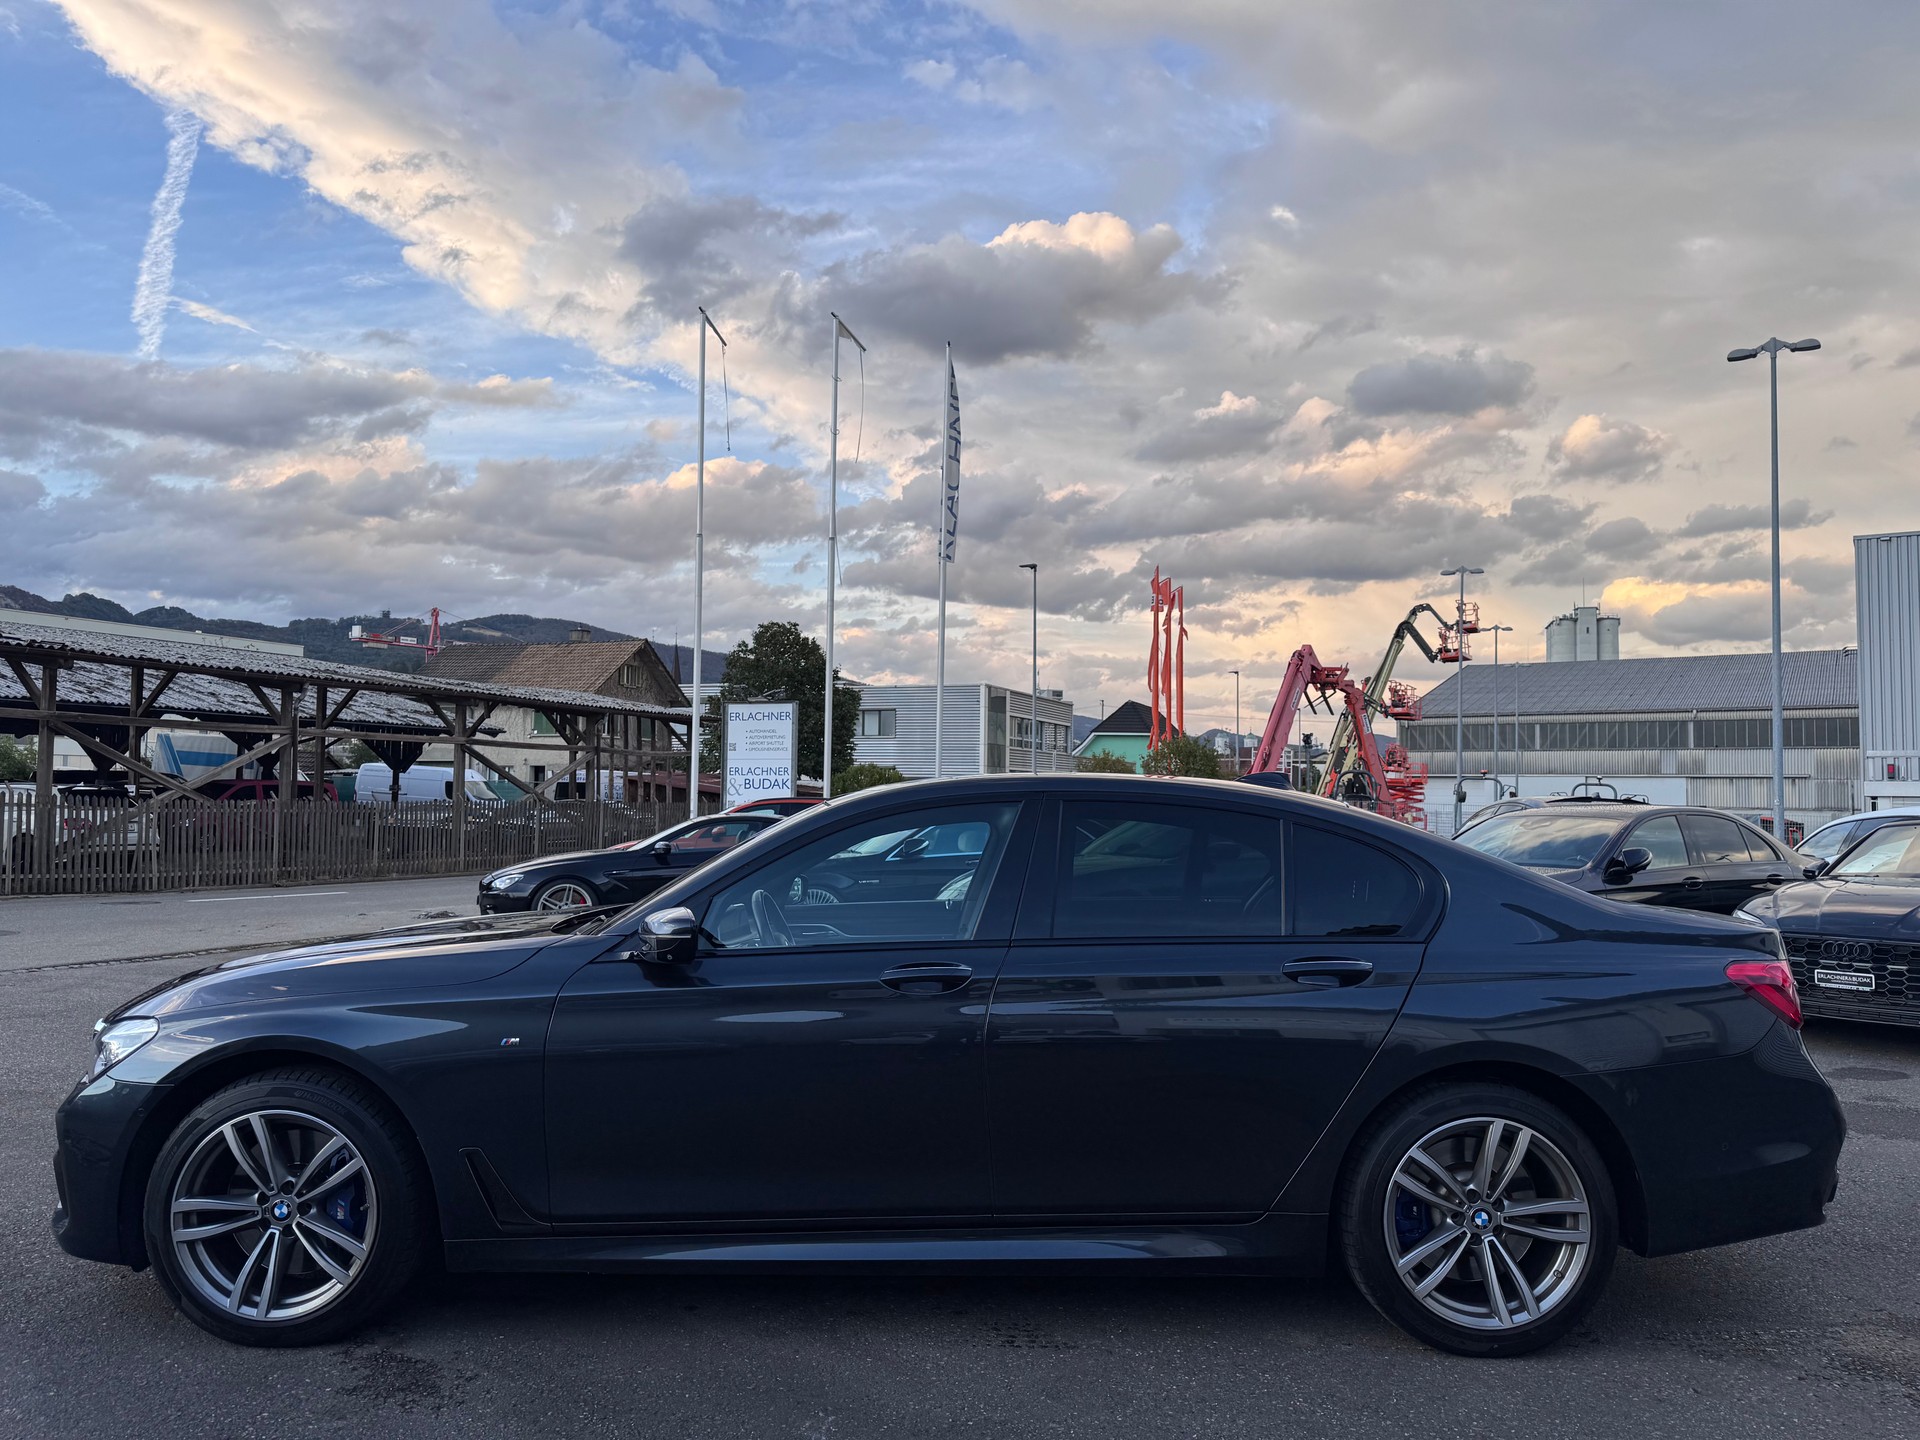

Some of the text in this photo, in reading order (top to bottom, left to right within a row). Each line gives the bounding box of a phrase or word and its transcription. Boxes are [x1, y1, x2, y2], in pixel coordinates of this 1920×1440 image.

[729, 712, 792, 721] ERLACHNER
[728, 767, 790, 776] ERLACHNER
[727, 777, 790, 796] & BUDAK
